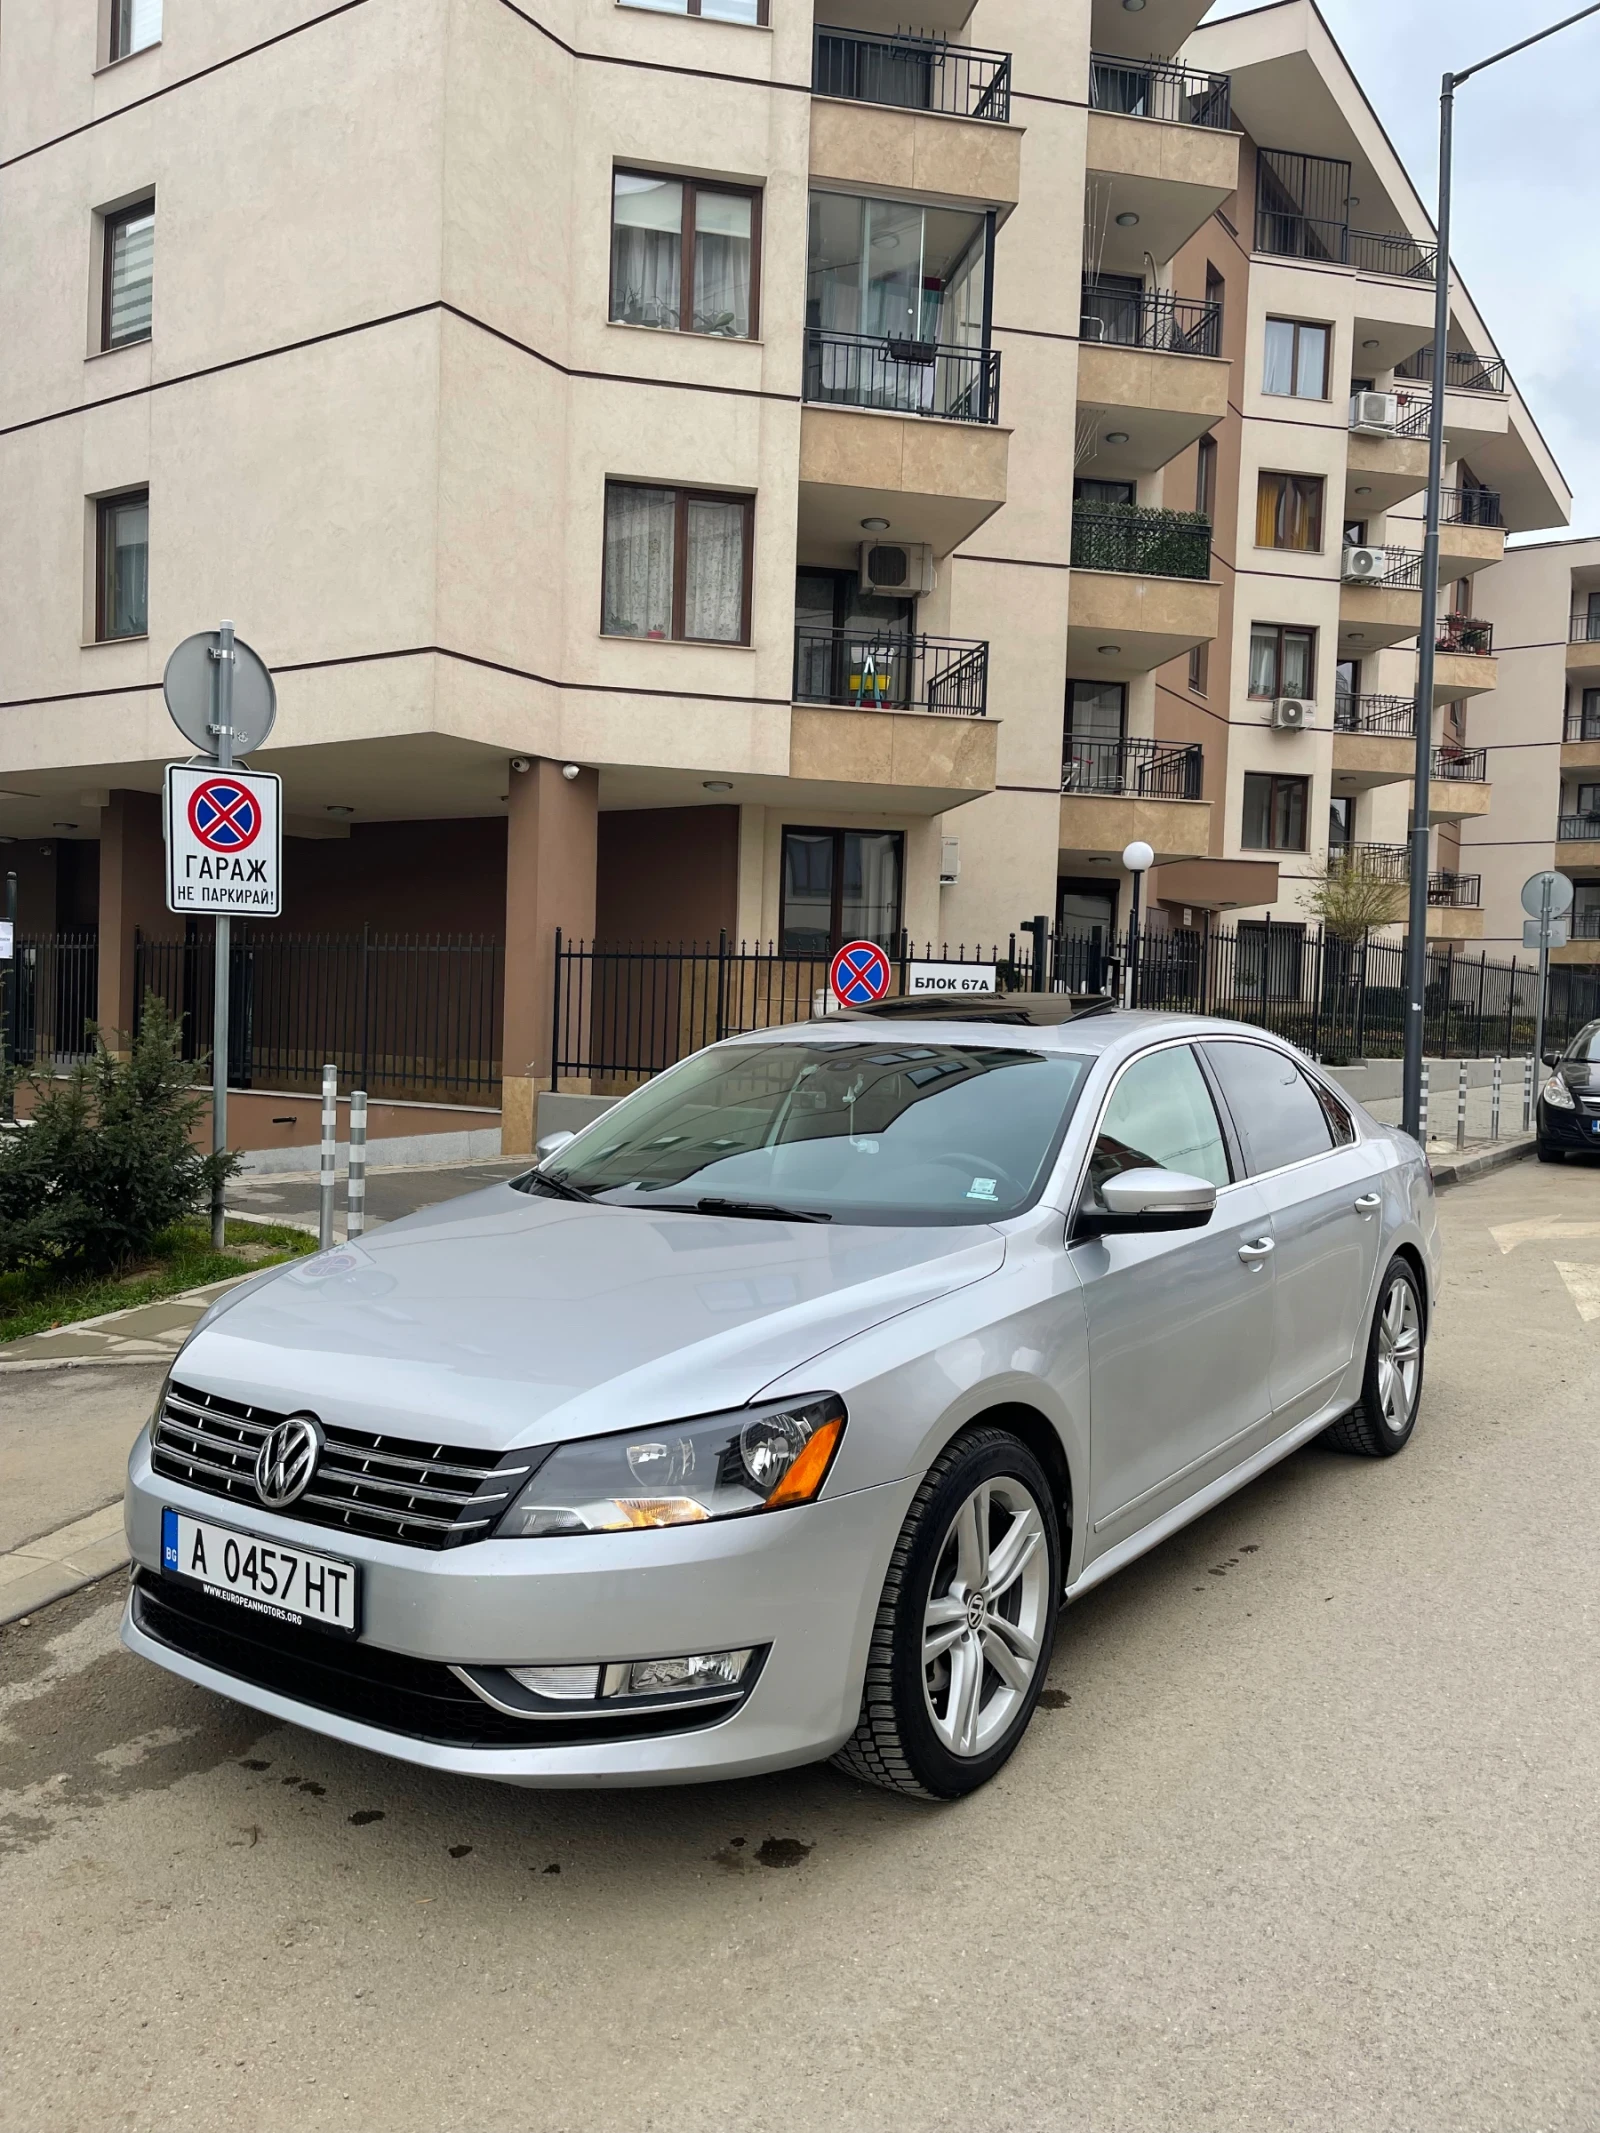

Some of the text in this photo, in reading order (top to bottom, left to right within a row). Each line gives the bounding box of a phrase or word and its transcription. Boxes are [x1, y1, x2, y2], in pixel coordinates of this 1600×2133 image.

[186, 854, 267, 883] ГАРАЖ
[177, 885, 274, 905] НЕ ПАРКИРАЙ!
[915, 978, 989, 990] БЛОК 67А
[166, 1546, 177, 1562] BG
[191, 1527, 208, 1575] A
[202, 1583, 302, 1626] WWW.EUROPEANMOTORS.ORG
